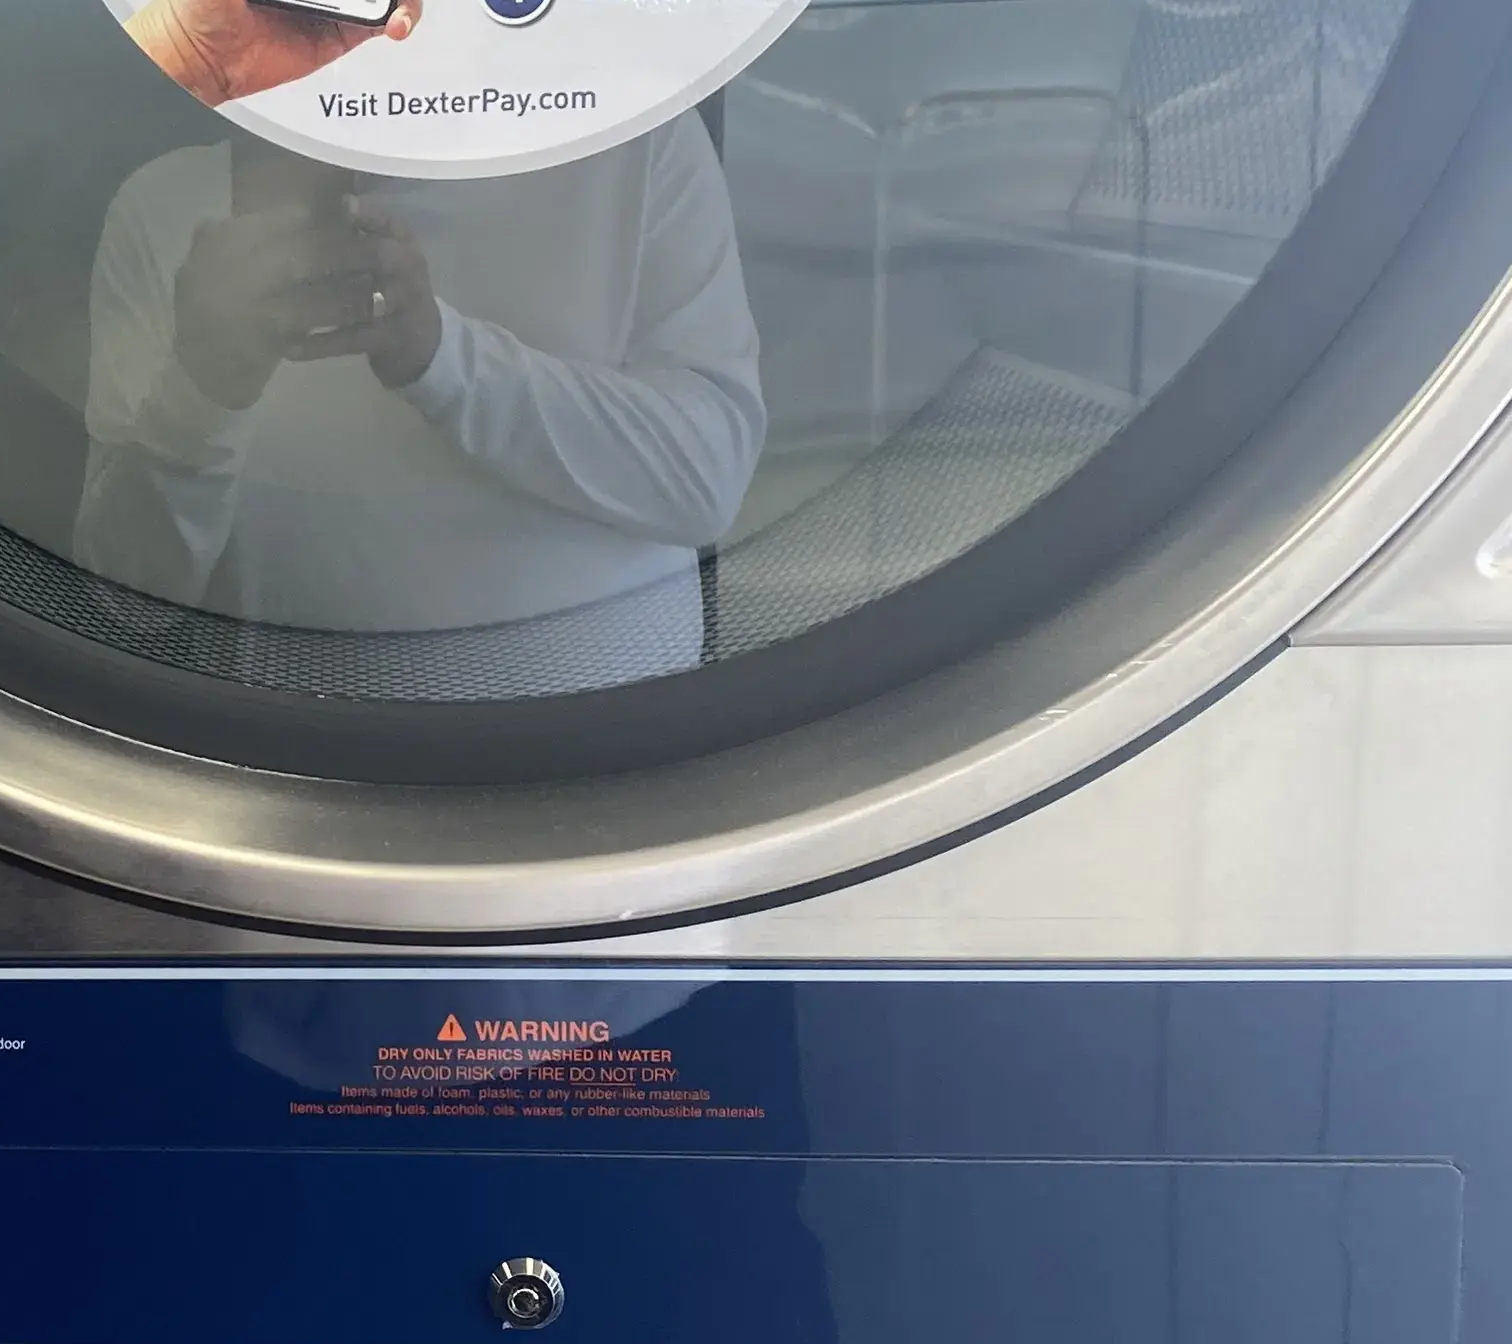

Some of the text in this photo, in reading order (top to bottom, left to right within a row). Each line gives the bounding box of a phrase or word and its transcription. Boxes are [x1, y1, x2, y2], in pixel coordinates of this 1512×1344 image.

[319, 88, 597, 118] Visit DexterPay.com
[475, 1020, 610, 1042] WARNING
[378, 1047, 672, 1063] DRY ONLY FABRICS WASHED IN WATER
[373, 1065, 637, 1083] TO AVOID RISK OF FIRE DO NOT
[341, 1086, 377, 1098] Items
[381, 1086, 418, 1098] made
[421, 1086, 435, 1098] of
[529, 1090, 543, 1100] or
[546, 1090, 570, 1102] any
[575, 1088, 646, 1101] rubber-like
[649, 1088, 711, 1102] materials
[290, 1103, 766, 1118] Items containing or other combustible materials
